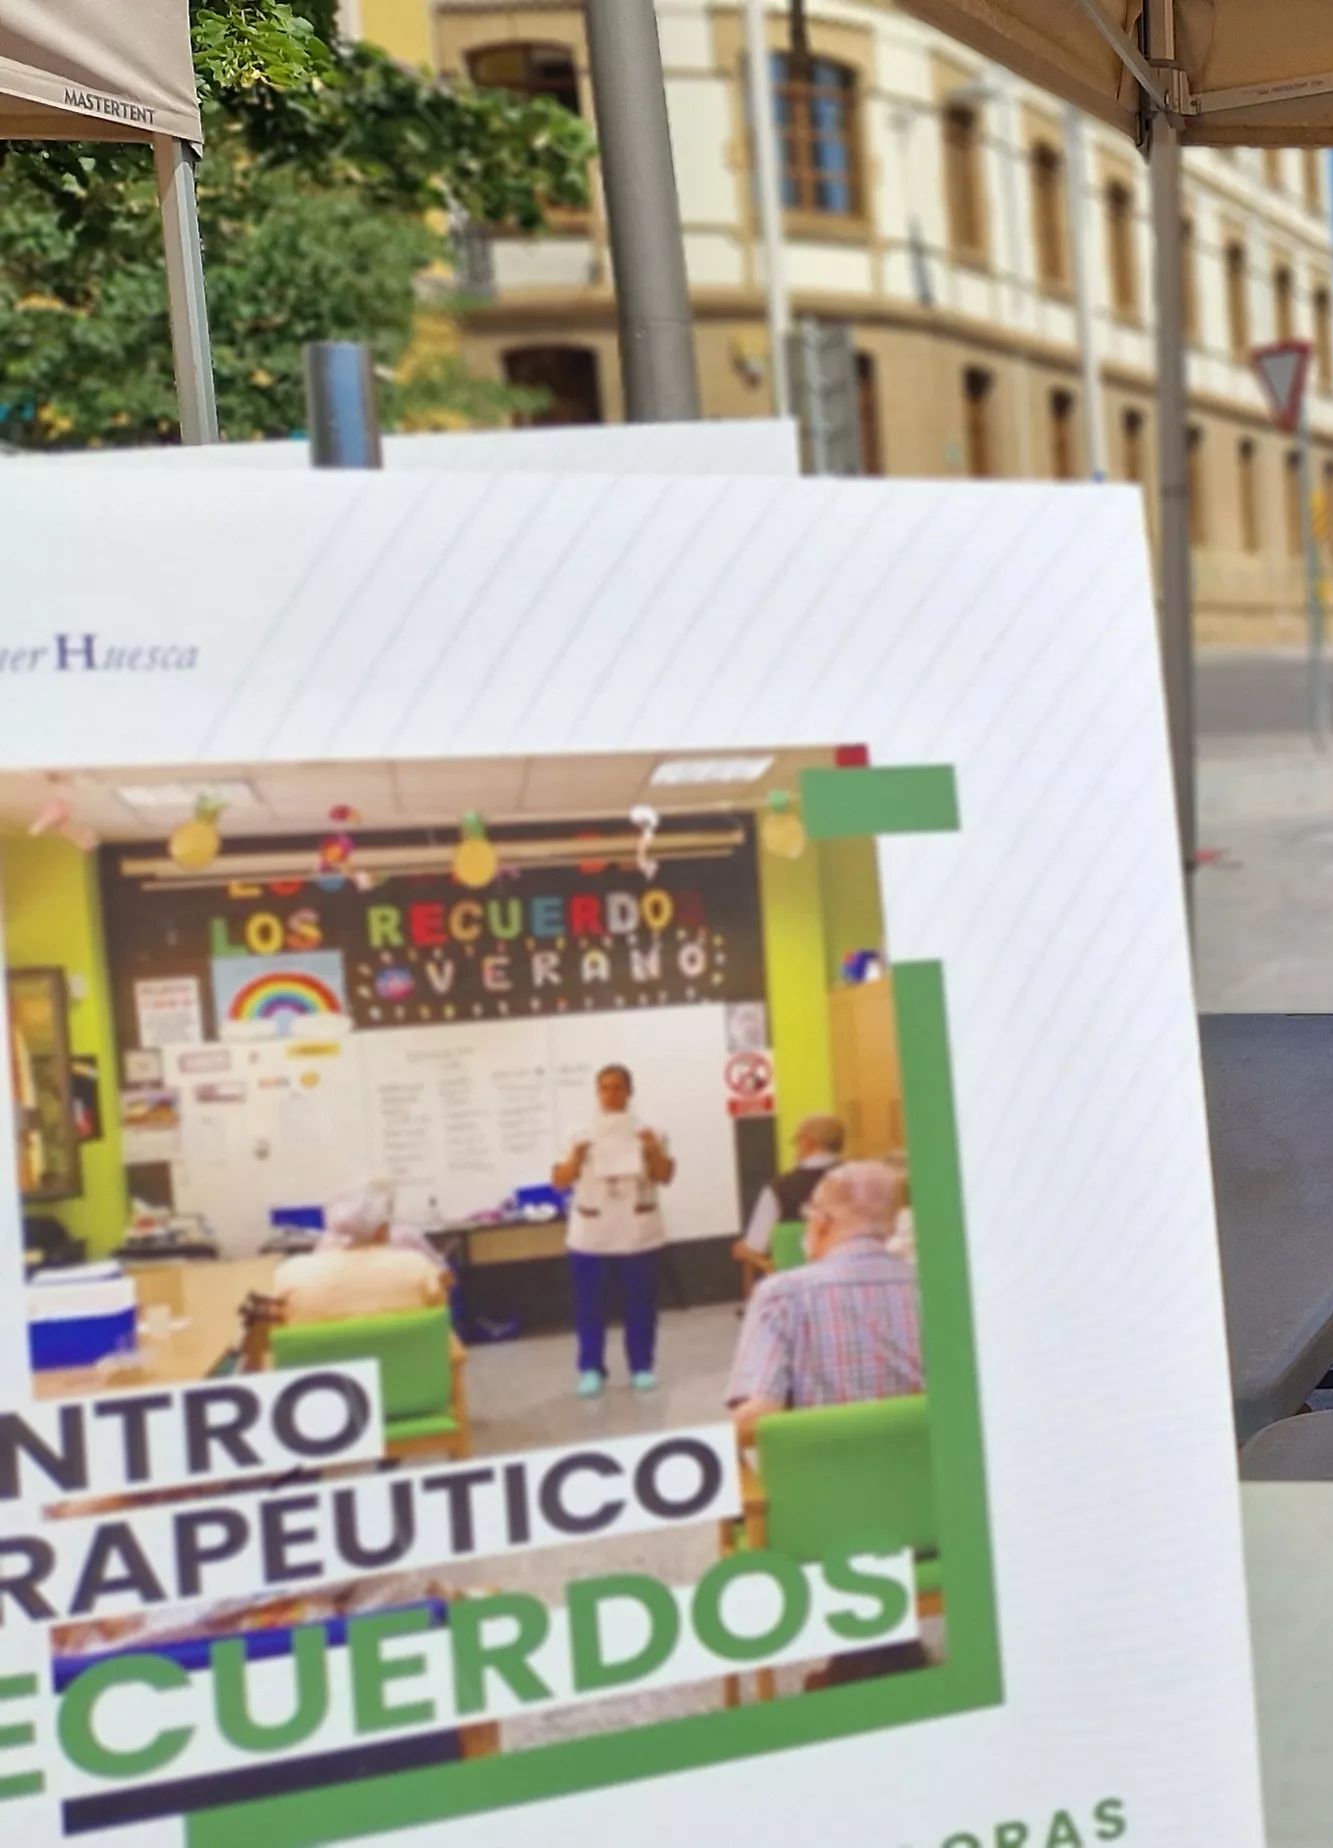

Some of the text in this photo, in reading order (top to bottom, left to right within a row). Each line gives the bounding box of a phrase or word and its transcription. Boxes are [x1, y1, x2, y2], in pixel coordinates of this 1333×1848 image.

[64, 87, 156, 125] MASTERTENT
[54, 633, 200, 672] Huesca
[211, 909, 323, 957] LOS
[426, 942, 706, 994] VERANO
